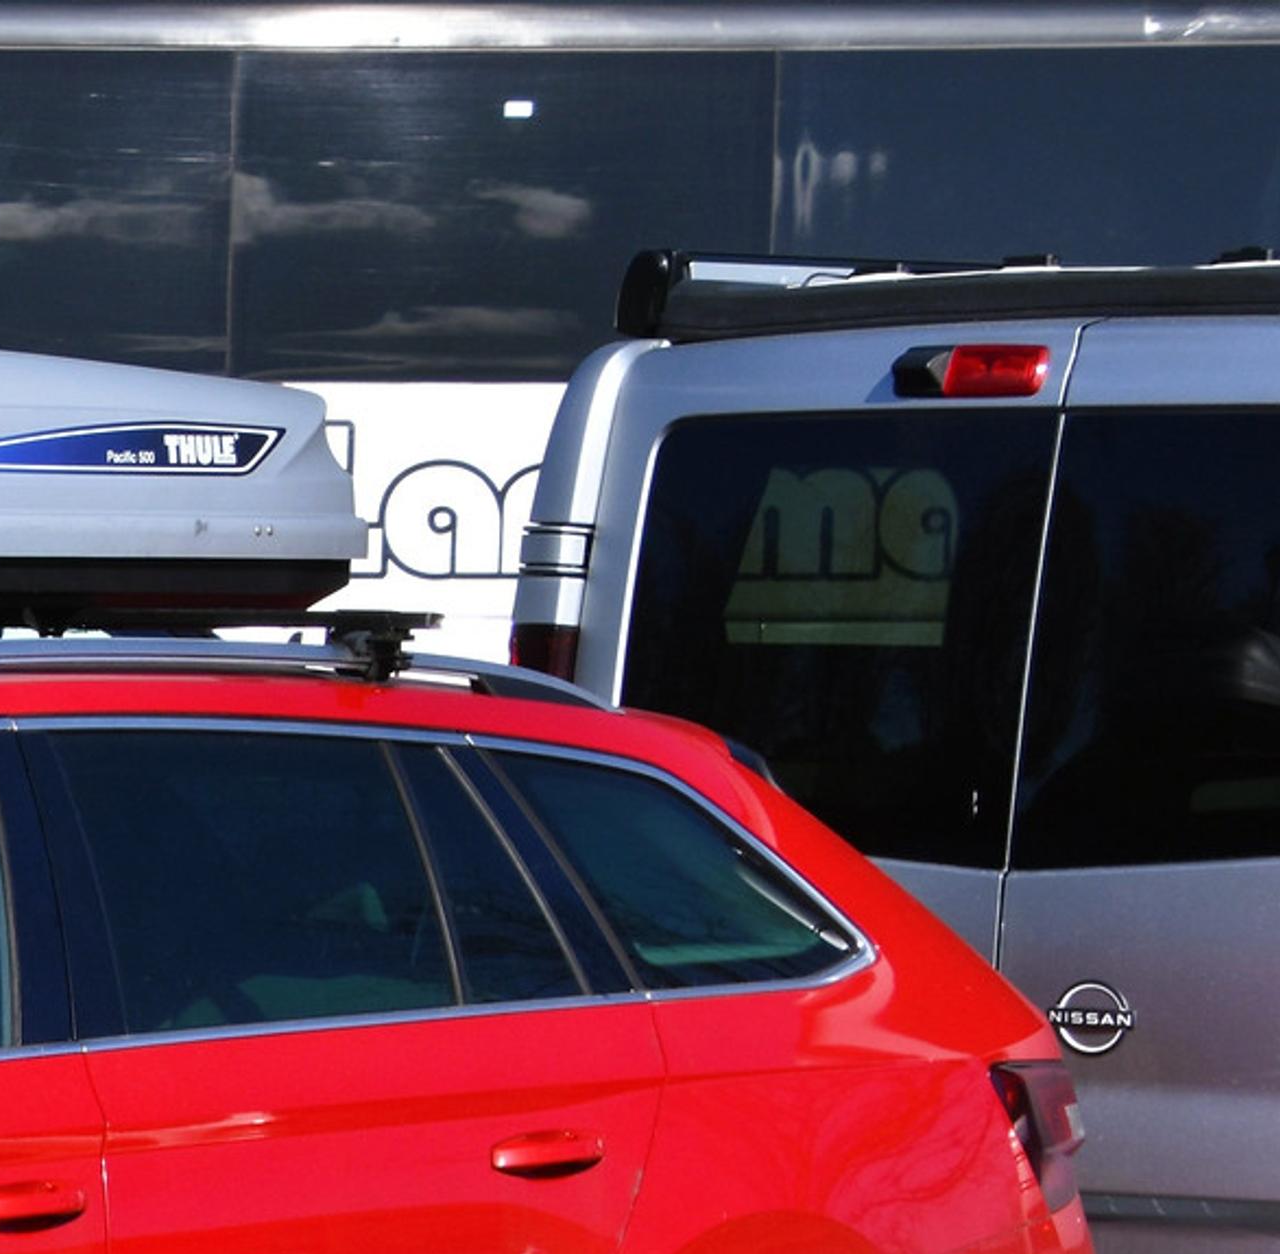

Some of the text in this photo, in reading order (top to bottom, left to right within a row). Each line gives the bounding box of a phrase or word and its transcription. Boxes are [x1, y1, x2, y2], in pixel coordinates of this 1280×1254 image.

[105, 449, 156, 464] Pacific 500
[163, 432, 238, 465] THULE
[1049, 1010, 1132, 1027] NISSAN
